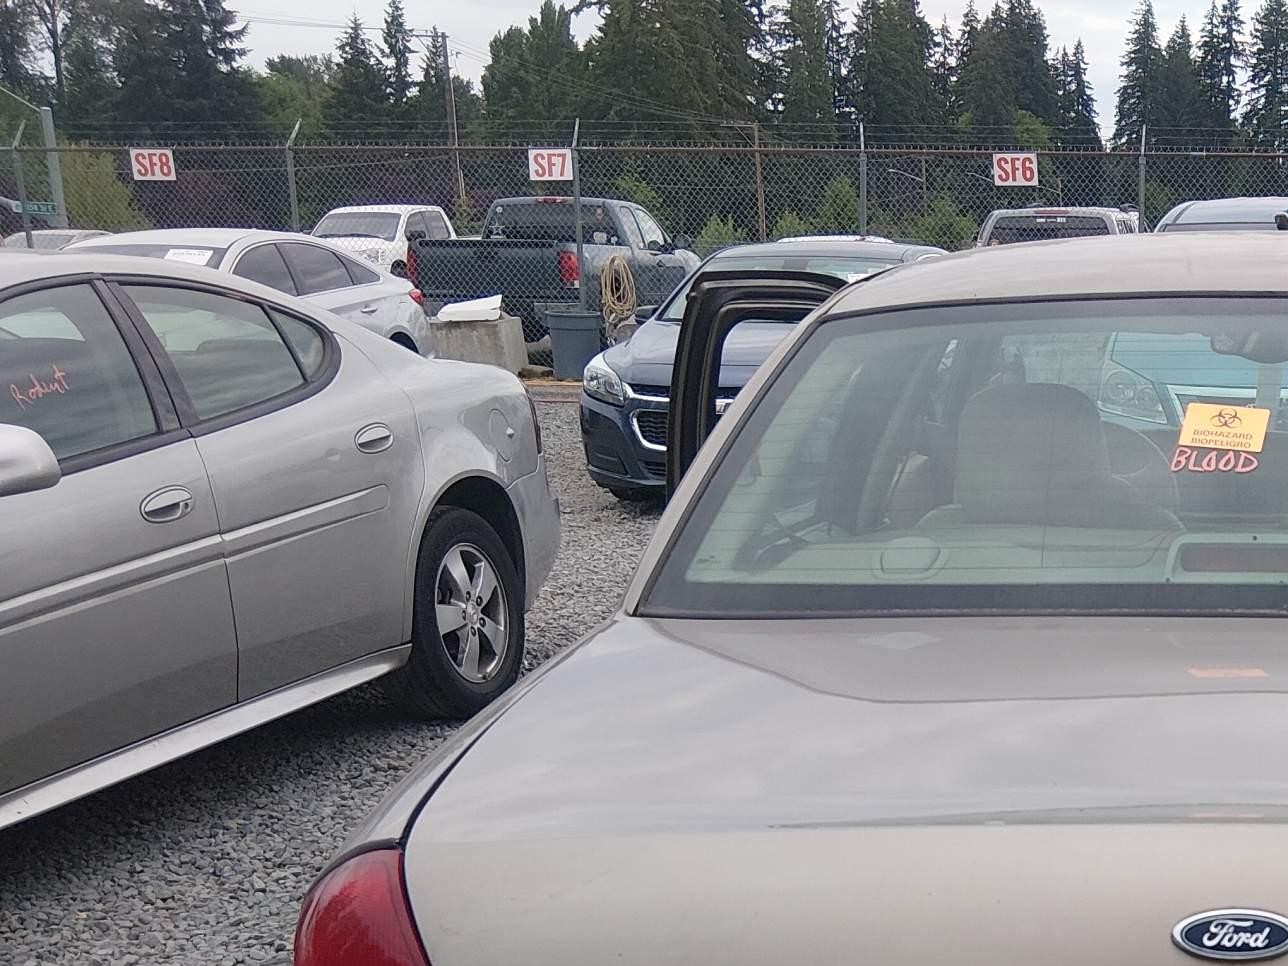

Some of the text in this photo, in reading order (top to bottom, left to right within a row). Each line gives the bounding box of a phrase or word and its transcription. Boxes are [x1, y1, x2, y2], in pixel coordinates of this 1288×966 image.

[134, 152, 172, 177] SF8
[533, 153, 567, 178] SF7
[996, 156, 1035, 182] SF6
[1190, 437, 1252, 449] BIOPELIGRO
[1192, 428, 1254, 441] BIOHAZARD
[1170, 446, 1259, 473] BLOOD
[1202, 919, 1272, 948] Ford
